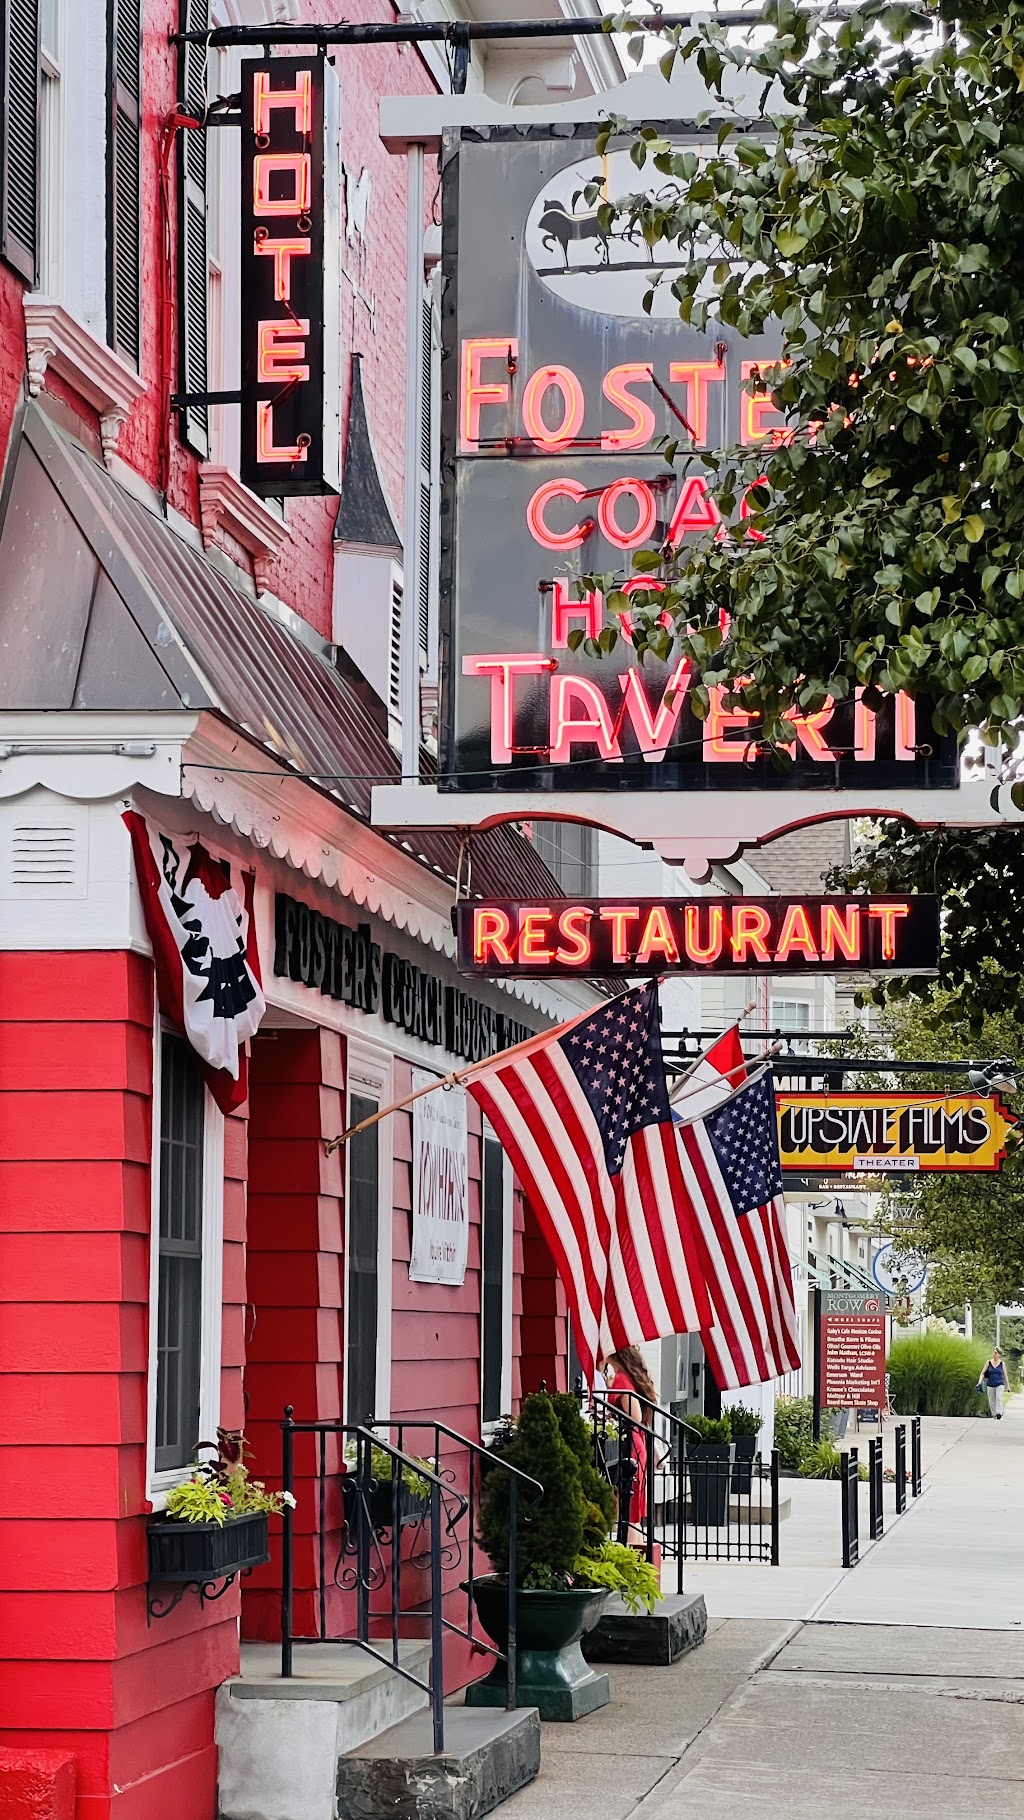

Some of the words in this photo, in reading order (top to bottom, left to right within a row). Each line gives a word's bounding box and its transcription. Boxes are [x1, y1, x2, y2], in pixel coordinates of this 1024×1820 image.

[254, 71, 311, 463] HOTEL
[460, 338, 855, 453] FOSTE
[473, 904, 909, 965] RESTAURANT
[274, 893, 381, 1014] FOSTER'S
[382, 953, 446, 1046] COACH
[789, 1105, 897, 1145] UPSTATE
[908, 1105, 992, 1145] FILMS
[858, 1159, 915, 1167] THEATER
[827, 1298, 864, 1311] ROW
